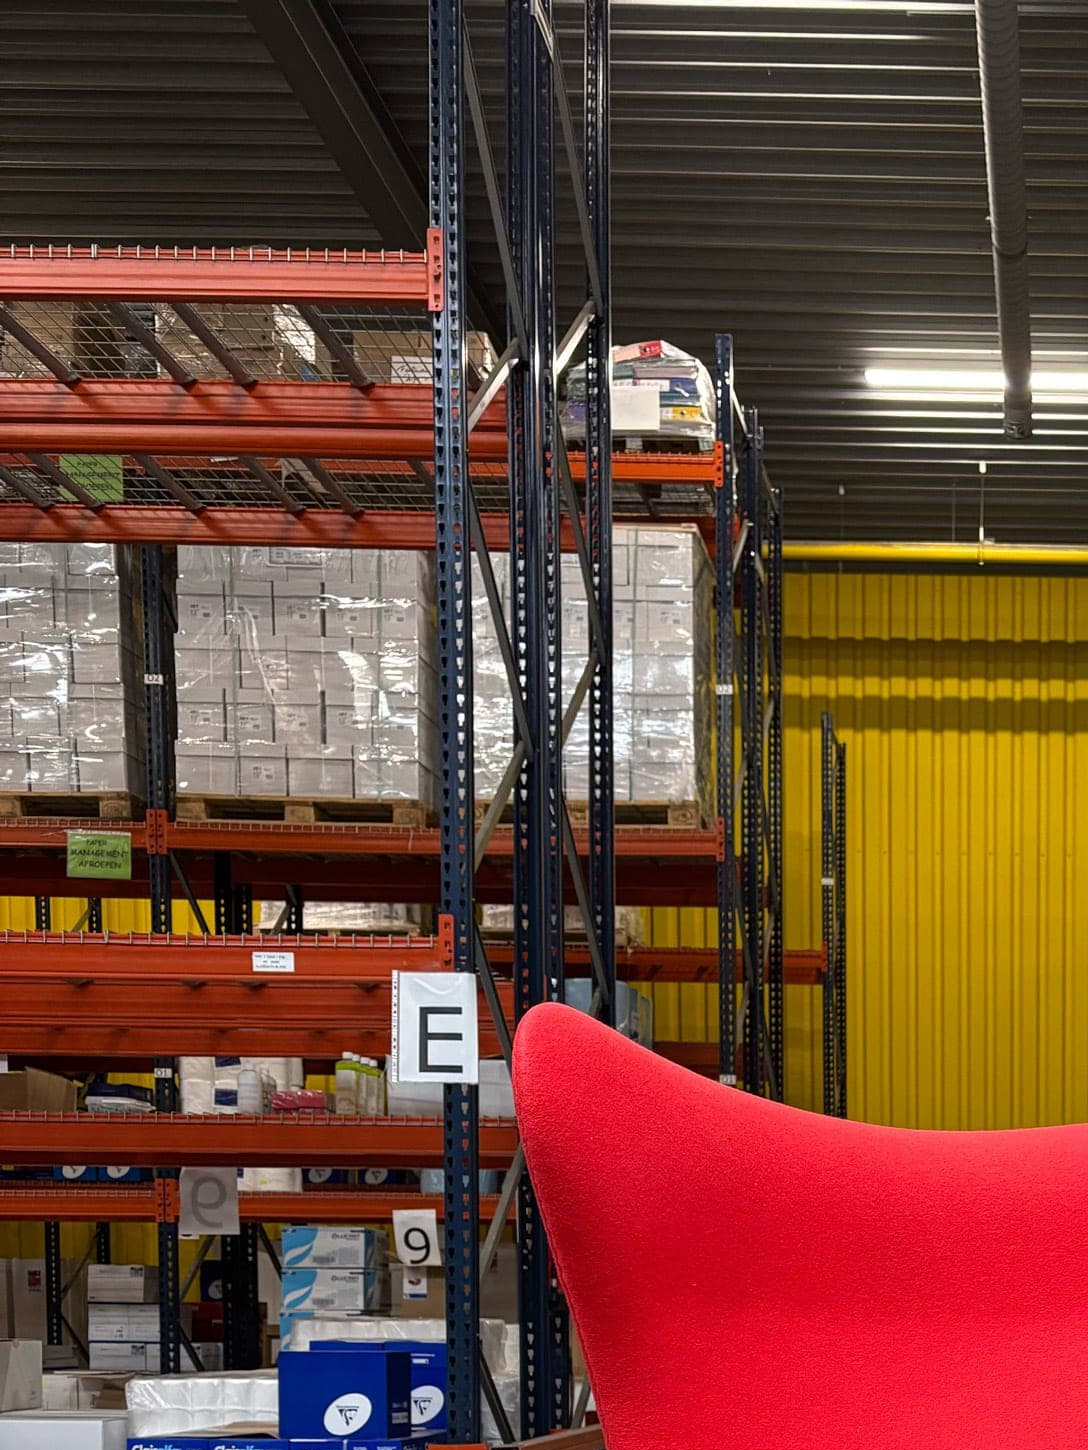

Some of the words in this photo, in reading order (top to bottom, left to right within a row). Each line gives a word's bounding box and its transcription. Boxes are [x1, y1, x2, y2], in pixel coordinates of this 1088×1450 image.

[71, 849, 128, 858] MANAGEMENT
[419, 1006, 463, 1073] E
[403, 1227, 431, 1264] 9
